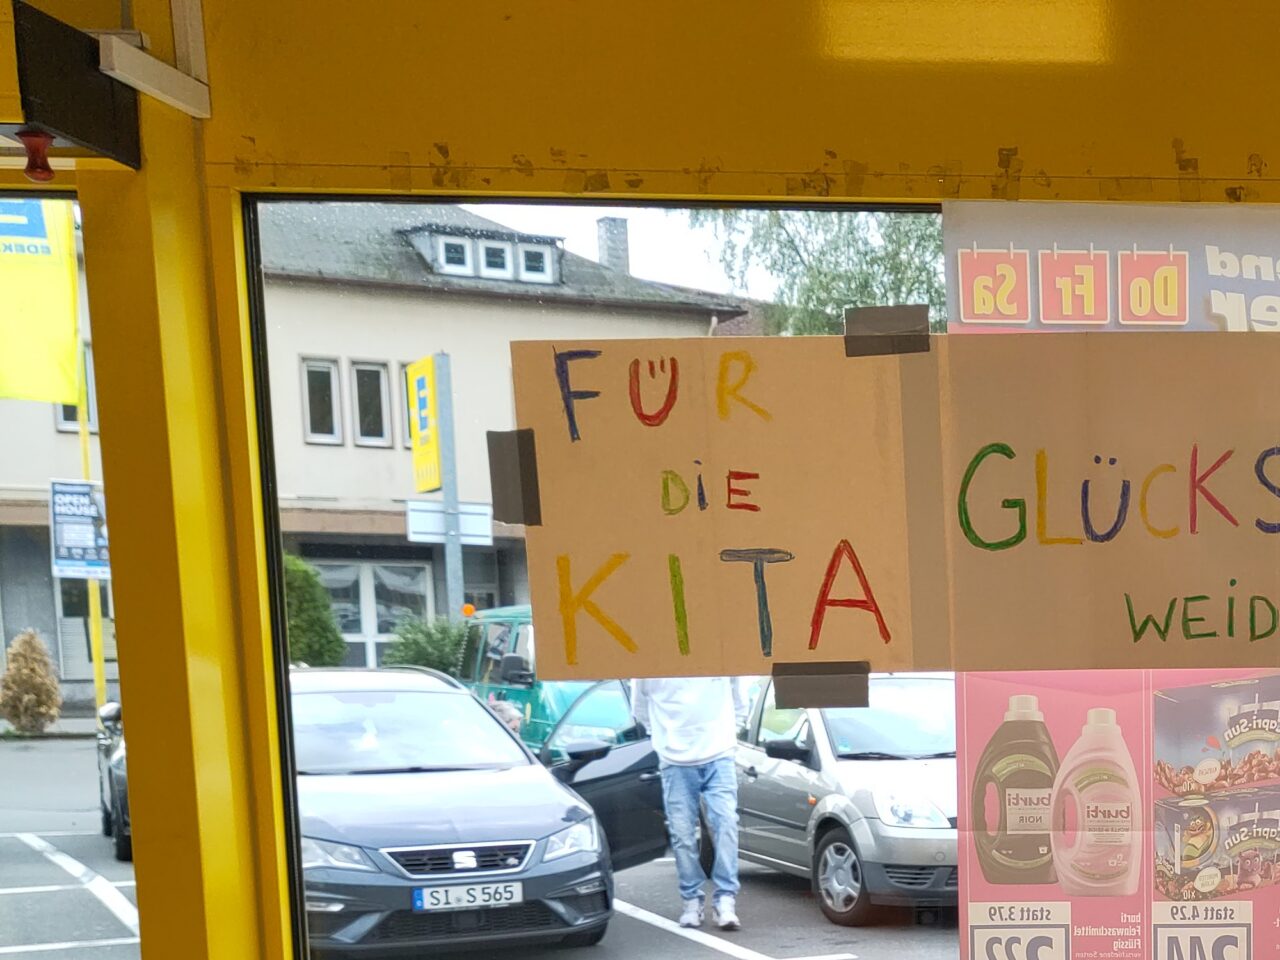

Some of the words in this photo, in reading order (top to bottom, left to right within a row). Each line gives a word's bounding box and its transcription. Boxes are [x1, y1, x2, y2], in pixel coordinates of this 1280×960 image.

[552, 345, 772, 443] FÜR
[55, 493, 90, 504] OPEN
[55, 504, 98, 517] HOUSE
[556, 538, 892, 665] KITA
[430, 889, 451, 906] SI
[466, 888, 476, 903] S
[482, 885, 514, 903] 565
